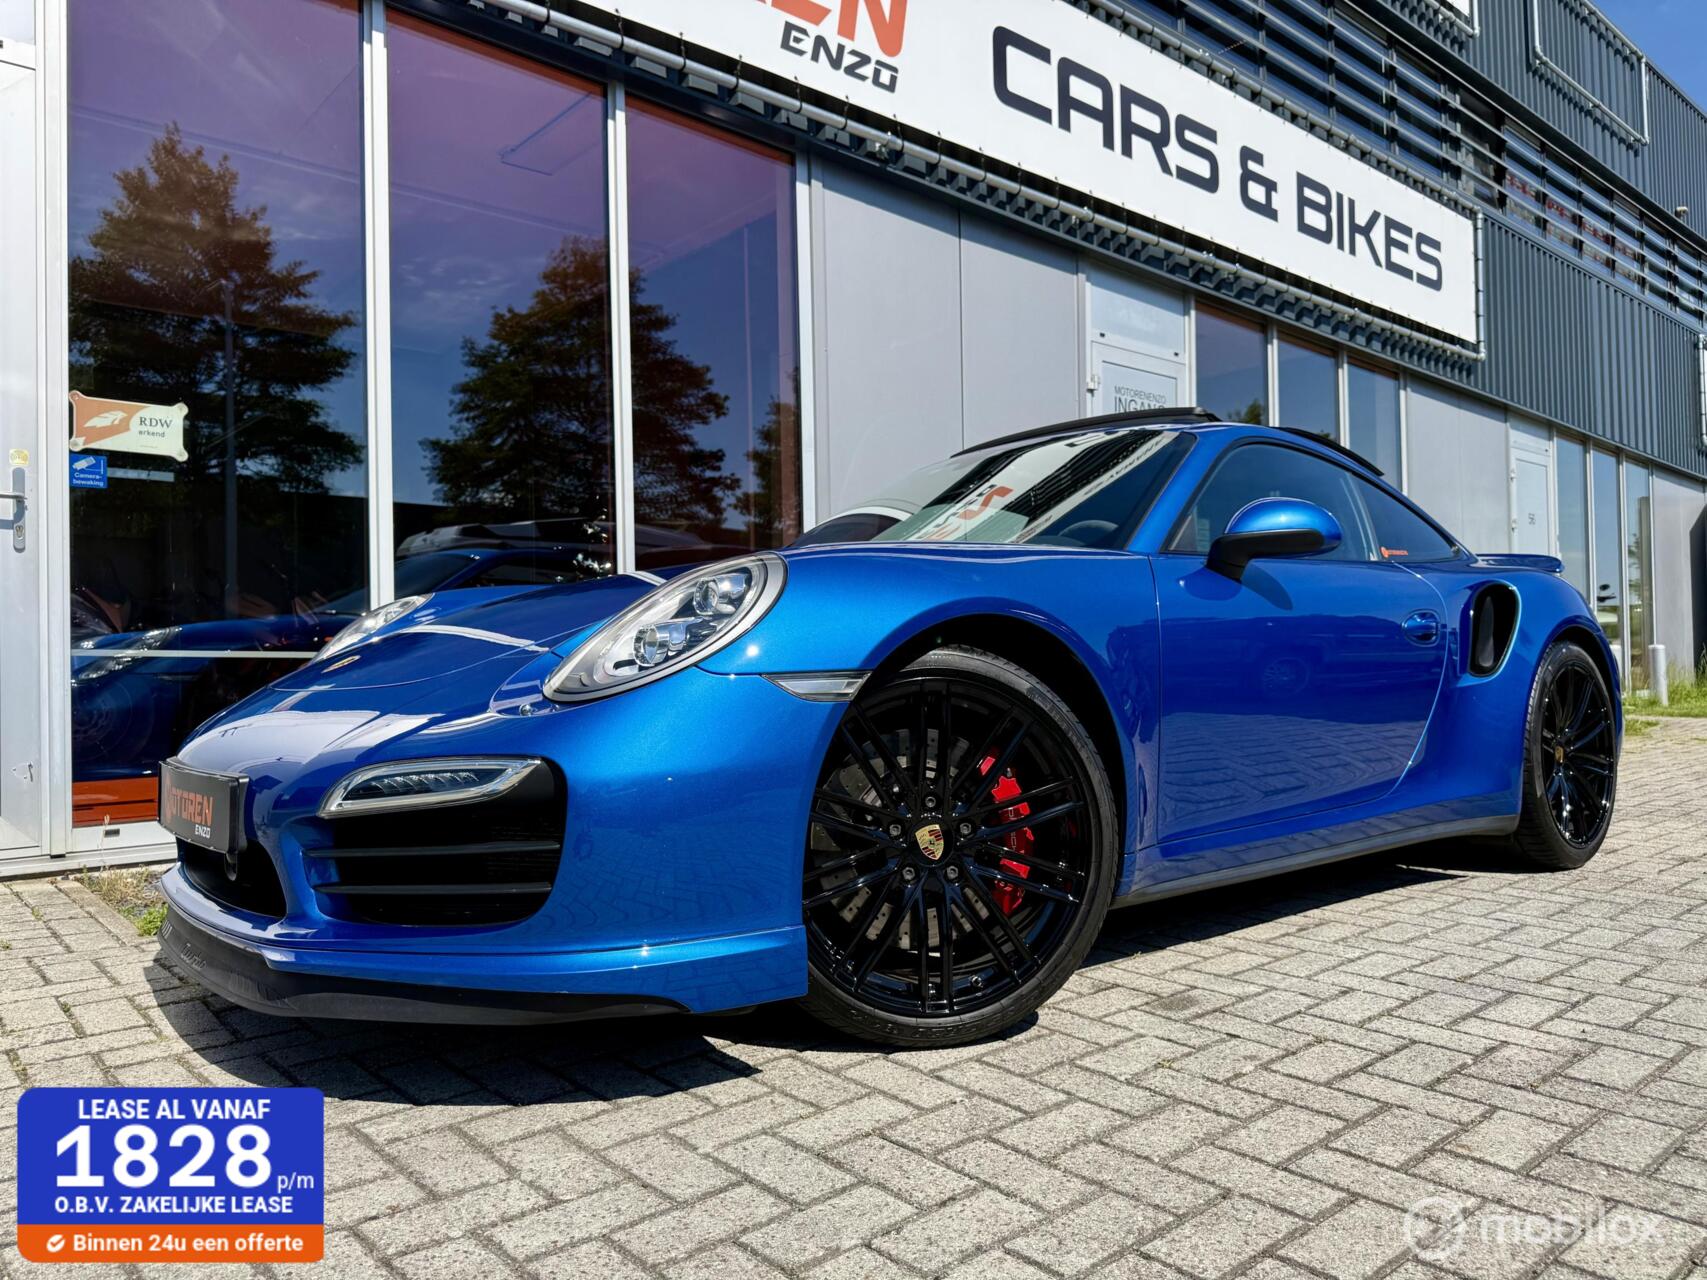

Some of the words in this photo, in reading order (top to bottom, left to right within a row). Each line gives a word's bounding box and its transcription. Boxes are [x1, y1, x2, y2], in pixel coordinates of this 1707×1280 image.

[780, 20, 899, 94] ENZO
[992, 25, 1220, 194] CARS
[1238, 145, 1279, 221] &
[1295, 170, 1443, 292] BIKES
[1114, 395, 1166, 413] INGA
[139, 416, 173, 429] RDW
[138, 430, 166, 438] erkend
[72, 479, 104, 487] bewaking
[195, 824, 211, 838] ENZO
